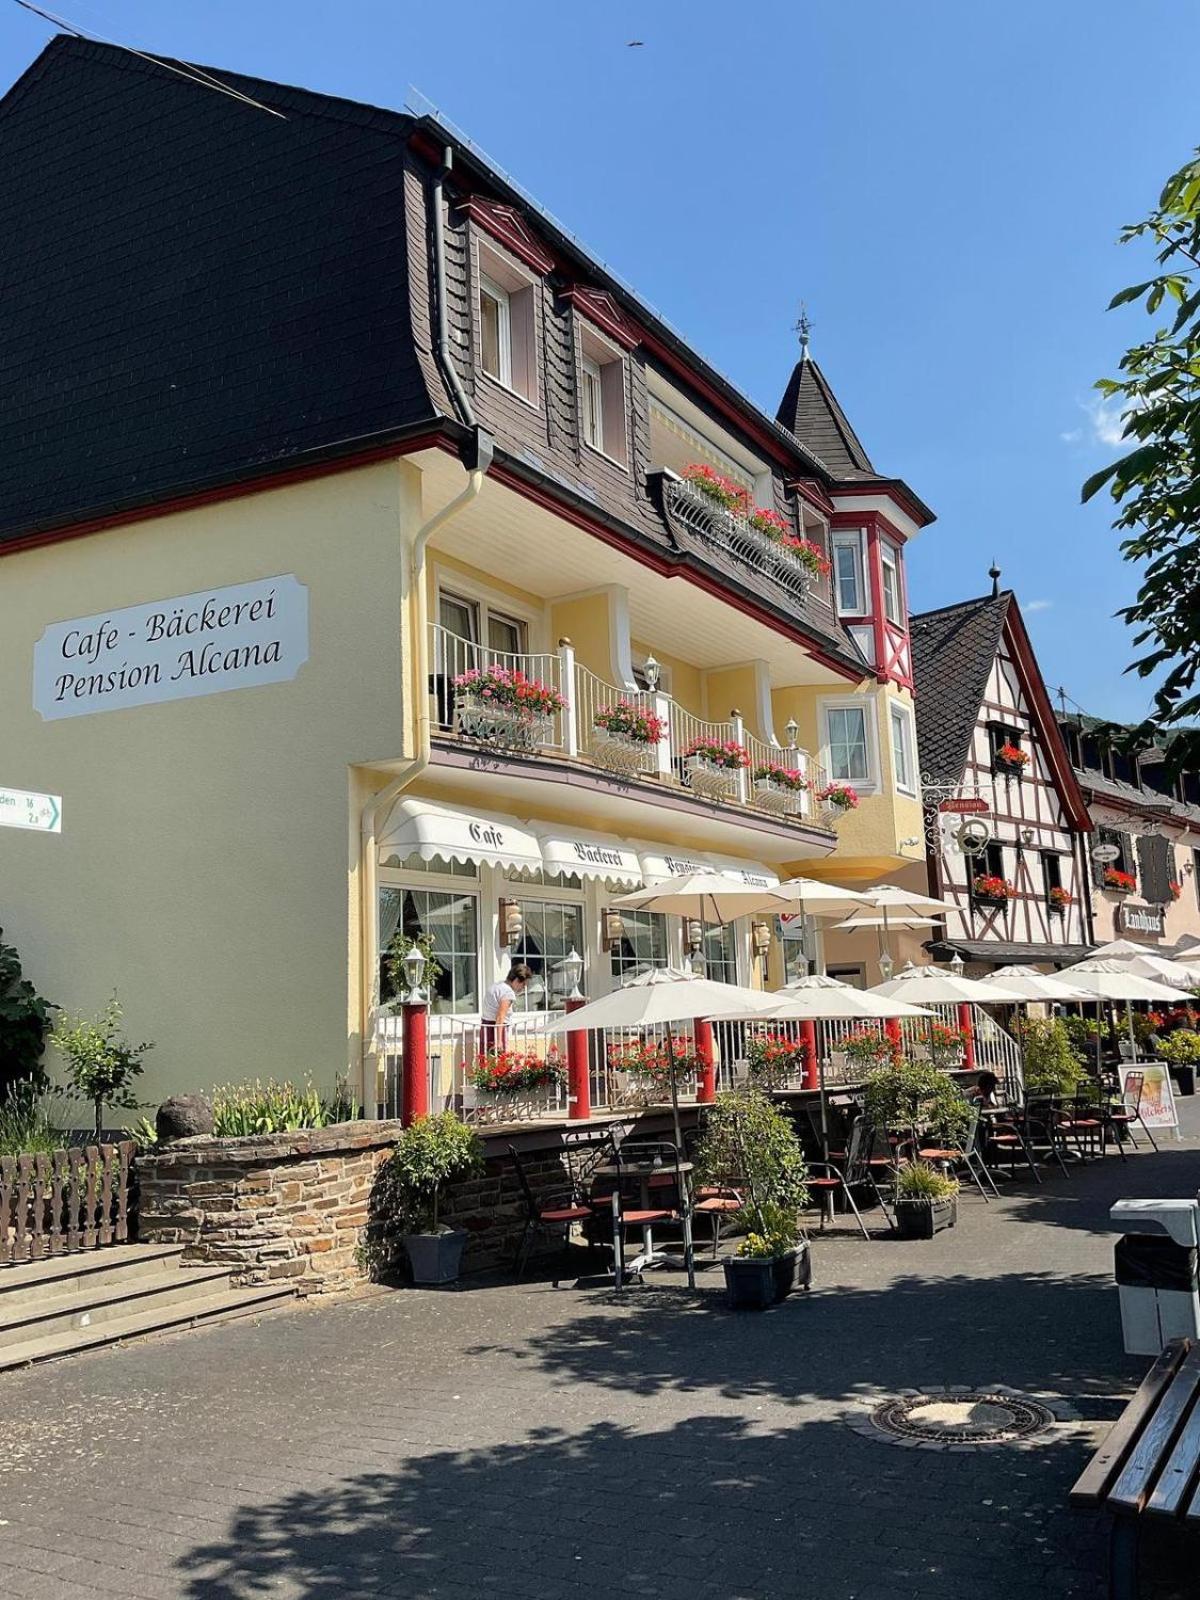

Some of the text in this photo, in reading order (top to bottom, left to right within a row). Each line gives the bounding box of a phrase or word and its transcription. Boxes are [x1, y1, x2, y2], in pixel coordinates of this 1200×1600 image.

[61, 620, 119, 664] Cafe
[146, 588, 276, 642] Bäckerei
[55, 640, 283, 701] Pension Alcana
[468, 822, 504, 850] Cafe
[573, 842, 623, 867] Bäckerei
